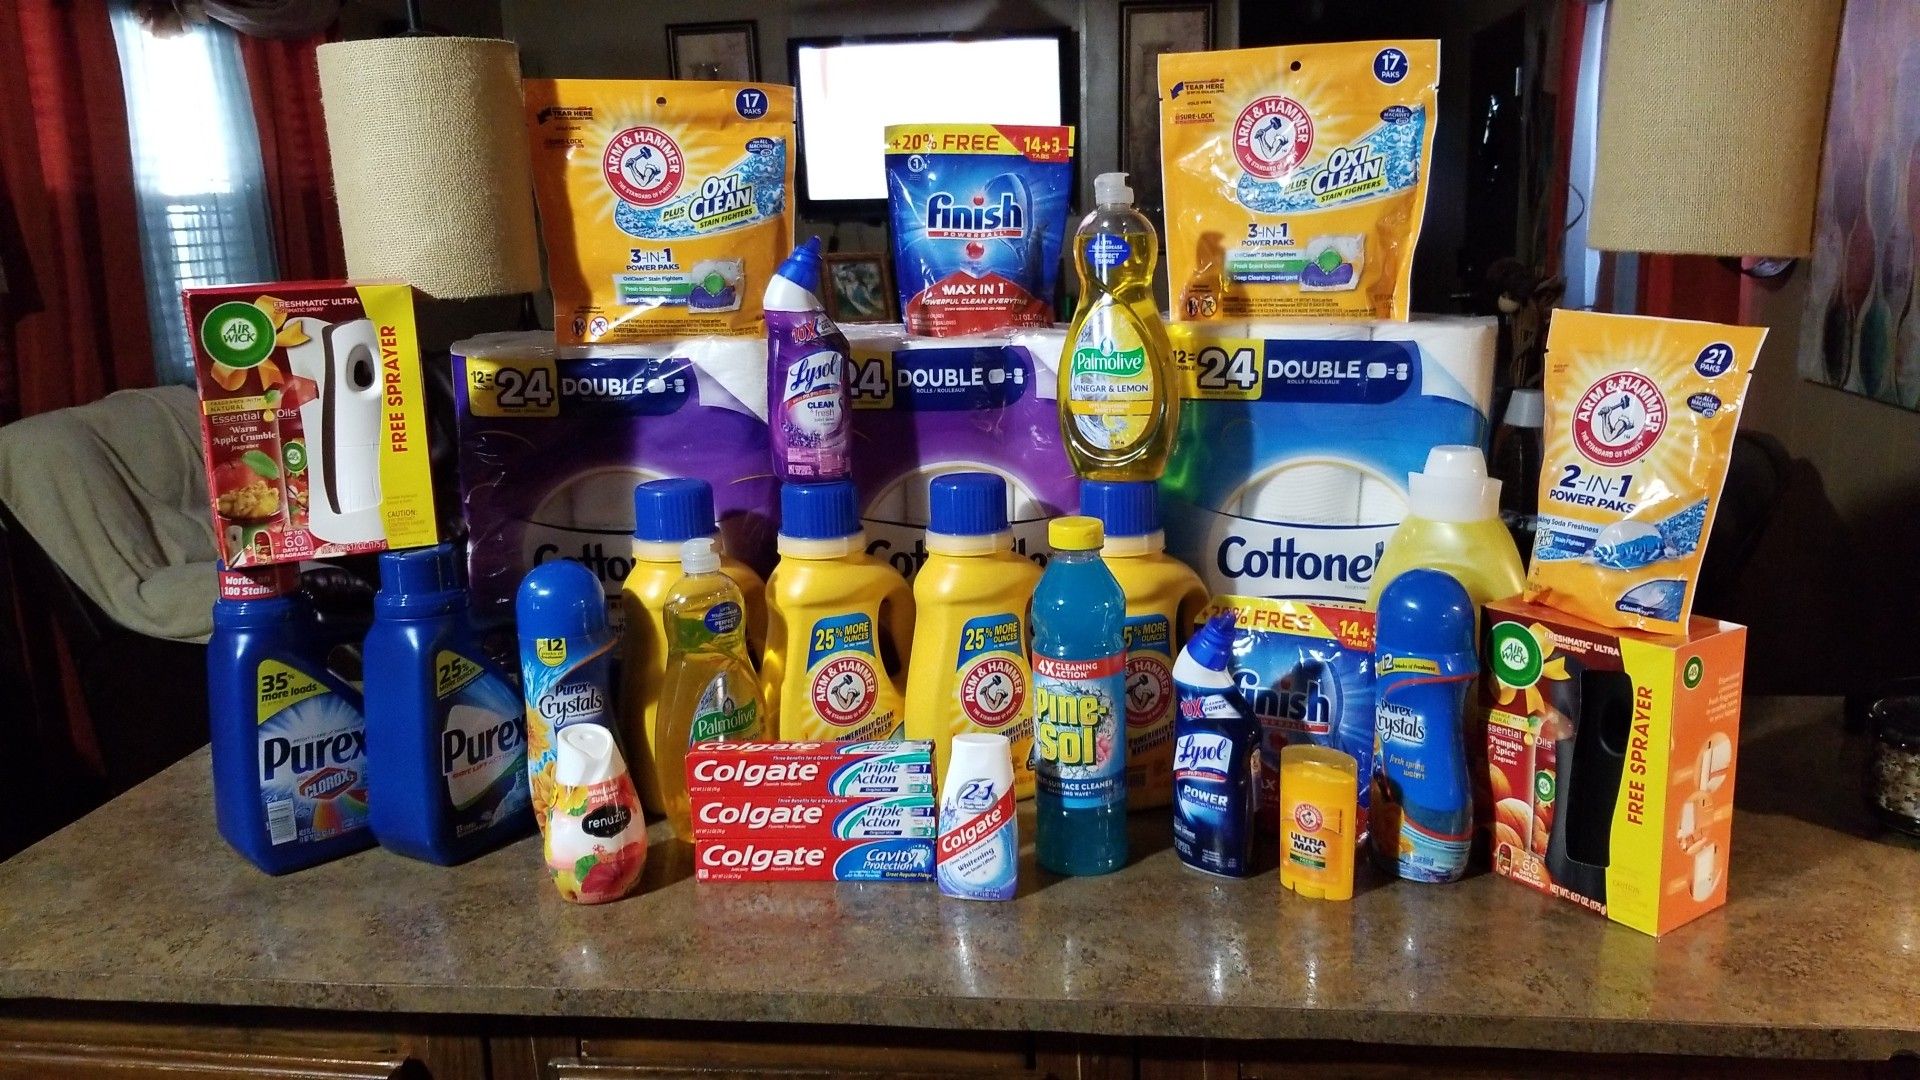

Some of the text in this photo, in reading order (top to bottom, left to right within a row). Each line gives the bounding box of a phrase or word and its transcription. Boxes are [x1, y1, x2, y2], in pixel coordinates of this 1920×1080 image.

[1382, 54, 1401, 71] 17
[742, 93, 760, 108] 17
[1238, 100, 1308, 147] ARM & HAMMER
[892, 133, 1000, 151] +20% FREE
[1024, 136, 1060, 153] 14+3
[608, 131, 680, 175] ARM & HAMMER
[1327, 145, 1370, 174] OXI
[1311, 157, 1383, 195] CLEAN
[702, 174, 739, 200] OXI
[1321, 180, 1382, 203] STAIN FIGHTERS
[663, 206, 685, 218] PLUS
[689, 186, 752, 222] CLEAN
[927, 192, 1024, 230] finish
[699, 208, 753, 228] STAIN FIGHTERS
[1248, 223, 1288, 238] 3-IN-1
[630, 248, 672, 264] 3-IN-1
[626, 264, 656, 272] POWER
[1248, 274, 1270, 282] Cleaning
[1271, 274, 1298, 282] Detergent
[942, 282, 1005, 296] MAX IN 1
[331, 297, 360, 306] ULTRA
[226, 320, 250, 336] AIR
[792, 320, 816, 344] 10X
[223, 332, 256, 344] WICK
[1077, 352, 1142, 371] Palmolive
[1704, 348, 1727, 364] 21
[790, 352, 838, 392] Lysol
[1196, 346, 1259, 390] 24
[1267, 360, 1362, 379] DOUBLE
[1700, 363, 1720, 372] PAKS
[897, 368, 984, 387] DOUBLE
[380, 326, 408, 452] FREE SPRAYER
[498, 369, 553, 406] 24
[562, 378, 645, 396] DOUBLE
[1074, 384, 1149, 393] VINEGAR LEMON
[808, 400, 834, 409] CLEAN
[815, 409, 834, 417] fresh
[1578, 376, 1662, 432] ARM HAMMER
[211, 408, 296, 424] Essential Oils
[213, 432, 278, 446] Apple Crumble
[1581, 430, 1590, 442] THE
[1586, 440, 1614, 458] STANDARD
[1624, 440, 1644, 458] PURITY
[1560, 464, 1633, 498] 2-IN-1
[1550, 490, 1636, 514] POWER PAKS
[1568, 522, 1599, 534] Freshness
[284, 536, 304, 548] 60
[1216, 536, 1385, 582] Cottonel
[225, 576, 254, 586] Works
[1143, 622, 1167, 634] MORE
[1254, 610, 1311, 632] FREE
[547, 639, 564, 652] 12
[814, 622, 869, 652] 25% MORE
[844, 632, 869, 643] OUNCES
[964, 622, 1018, 651] 25% MORE
[994, 632, 1018, 644] OUNCES
[1142, 632, 1166, 642] OUNCES
[1346, 640, 1368, 648] TABS
[1544, 632, 1620, 656] FRESHMATIC ULTRA
[1504, 642, 1524, 654] AIR
[1382, 654, 1393, 671] 12
[1502, 651, 1527, 664] WICK
[1038, 660, 1098, 676] 4X CLEANING
[1056, 670, 1089, 678] ACTION
[261, 672, 295, 694] 35%
[816, 660, 874, 702] ARM & HAMMER
[966, 661, 1022, 702] ARM HAMMER
[1134, 660, 1170, 695] HAMMER
[290, 682, 318, 696] loads
[556, 682, 588, 696] Purex
[539, 688, 602, 726] Crystals
[1036, 688, 1107, 726] Pine-
[1180, 696, 1204, 718] 10X
[1204, 704, 1227, 712] POWER
[1380, 700, 1414, 717] Purex
[698, 710, 756, 738] Palmolive
[836, 710, 894, 742] POWERFULLY CLEAN
[1376, 705, 1425, 744] Crystals
[444, 714, 528, 773] Purex
[1040, 722, 1098, 766] Sol
[1488, 724, 1552, 748] ssential Oils
[1489, 735, 1523, 752] Pumpkin
[264, 728, 366, 781] Purex
[1178, 735, 1227, 768] Lysol
[1390, 754, 1404, 766] fresh
[1496, 746, 1516, 758] Spice
[1628, 686, 1652, 826] FREE SPRAYER
[694, 760, 819, 787] Colgate
[863, 762, 900, 774] Triple
[1403, 770, 1425, 780] waters
[305, 772, 350, 798] CLOROX
[852, 774, 896, 784] Action
[1081, 779, 1113, 790] CLEANER
[1184, 784, 1228, 806] POWER
[588, 810, 628, 829] renuzit
[699, 802, 822, 829] Colgate
[866, 804, 904, 818] Triple
[856, 817, 900, 828] Action
[942, 810, 1002, 852] Colgate
[1290, 831, 1326, 848] ULTRA
[1294, 840, 1322, 854] MAX
[702, 844, 825, 872] Colgate
[866, 848, 916, 864] Cavity
[958, 848, 994, 872] Whitening
[862, 862, 912, 870] Protection
[1522, 860, 1539, 874] 60
